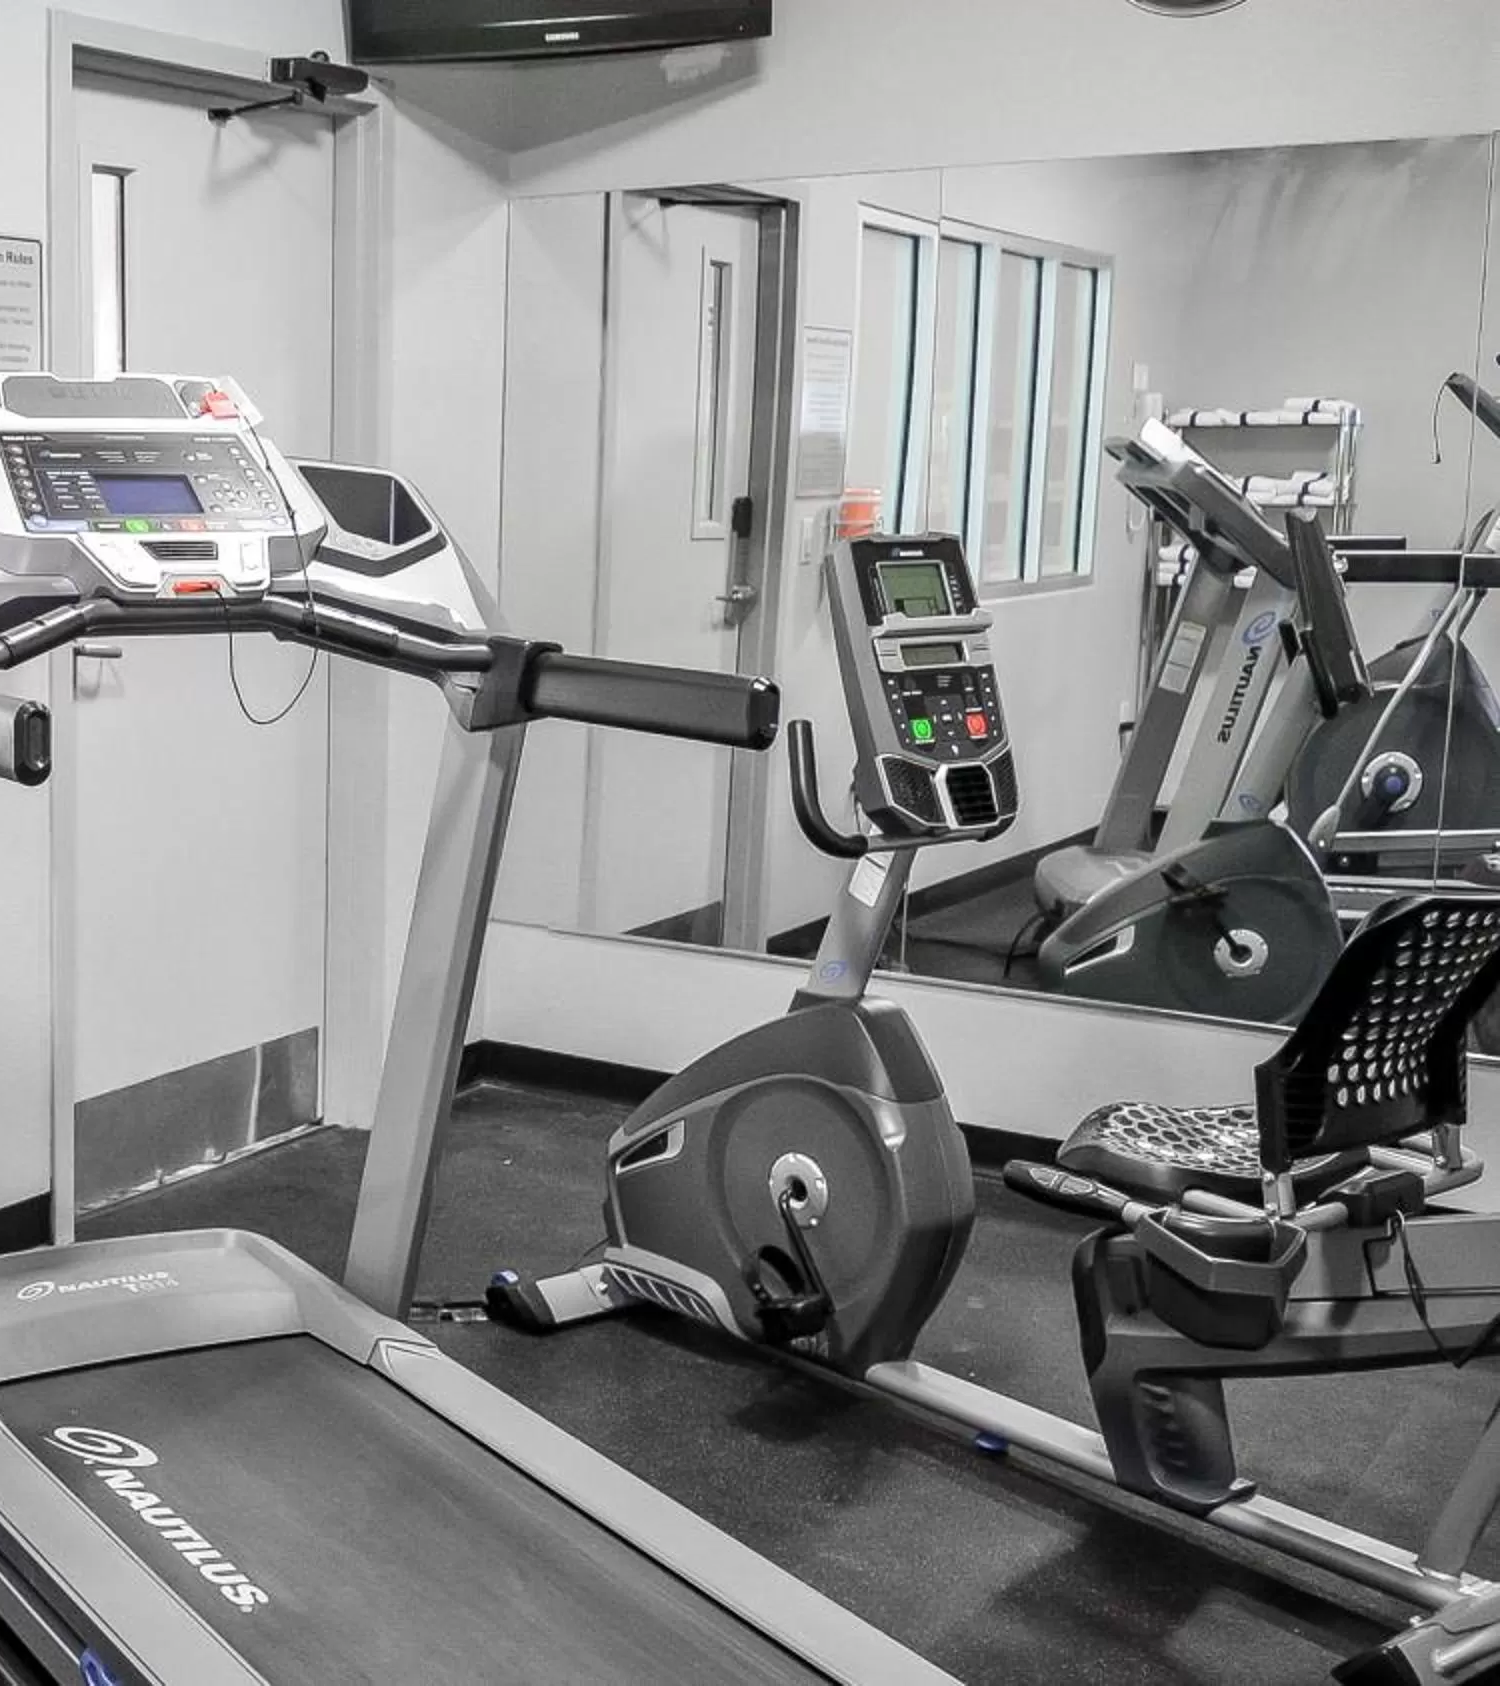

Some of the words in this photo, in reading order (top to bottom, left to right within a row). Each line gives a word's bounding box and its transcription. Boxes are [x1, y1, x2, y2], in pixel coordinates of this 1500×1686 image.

[6, 250, 34, 265] Rules
[58, 1271, 169, 1294] NAUTILUS
[94, 1468, 270, 1606] NAUTILUS
